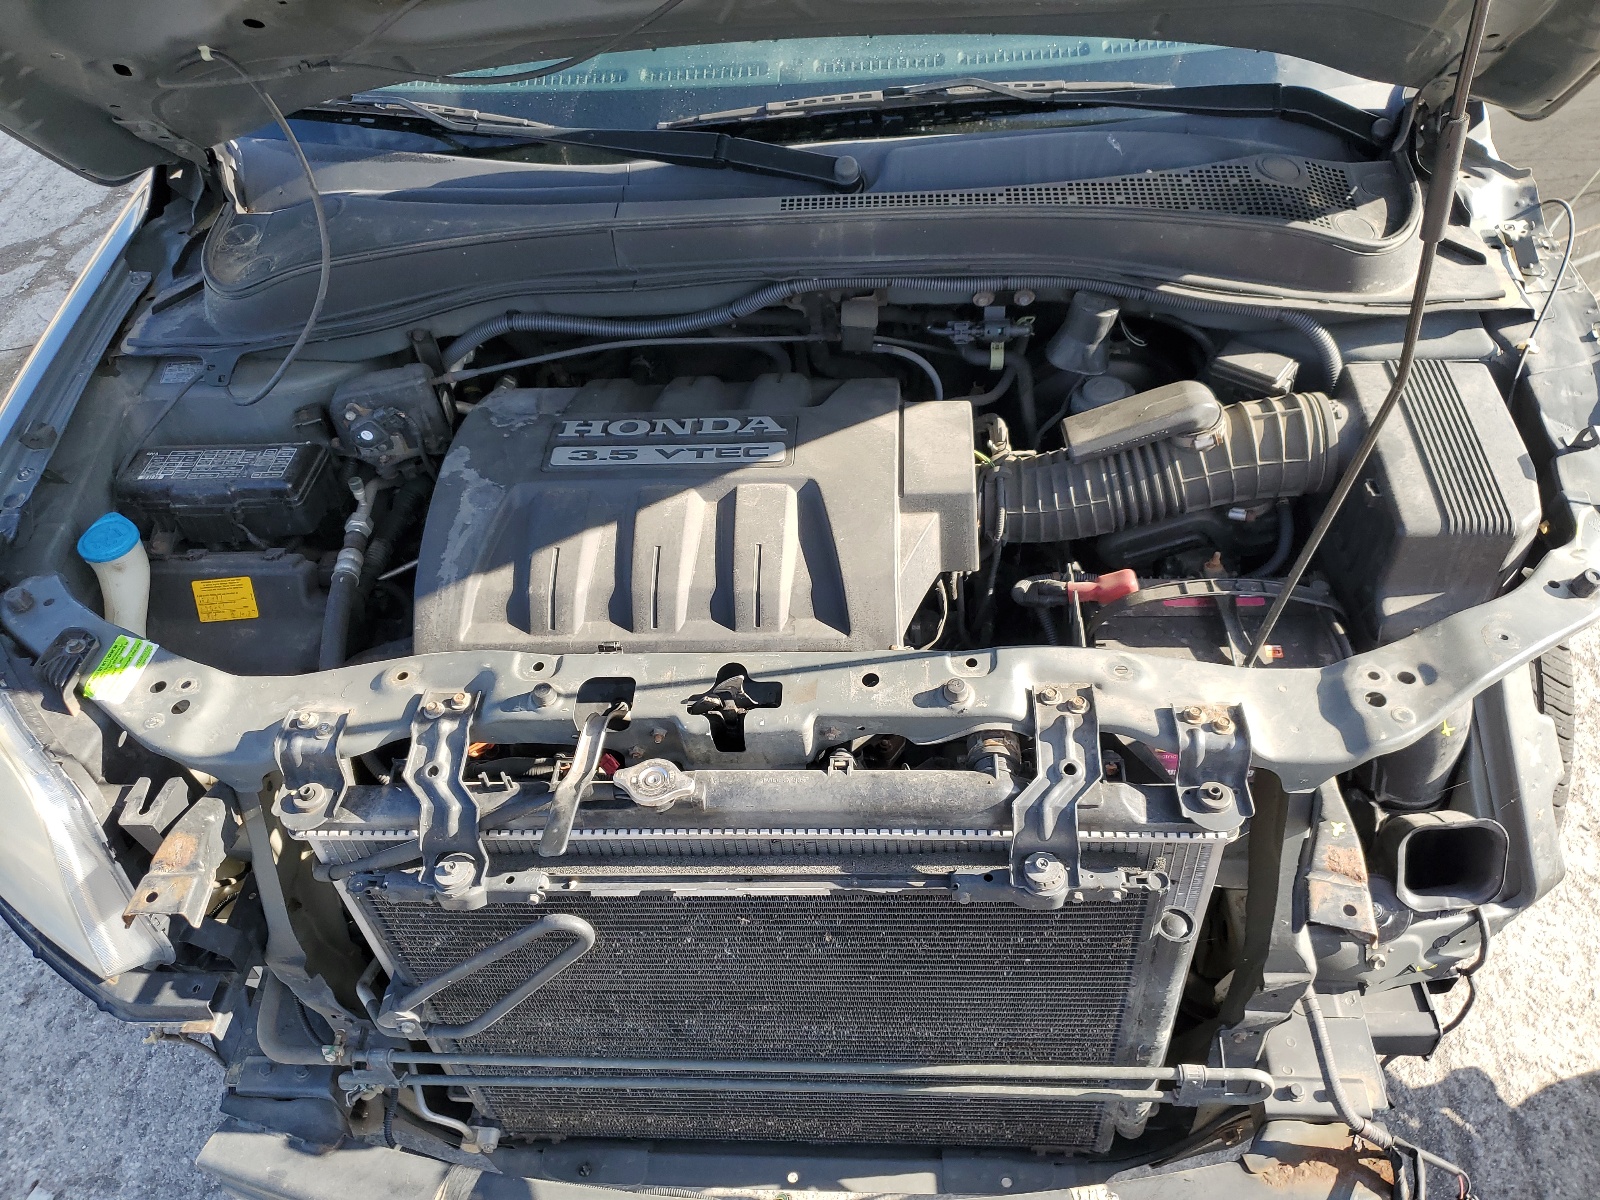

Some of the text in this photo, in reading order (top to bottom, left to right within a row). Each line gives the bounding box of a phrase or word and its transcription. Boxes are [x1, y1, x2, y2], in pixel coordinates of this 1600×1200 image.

[558, 416, 788, 438] HONDA
[567, 446, 769, 461] 3.5 VTEC
